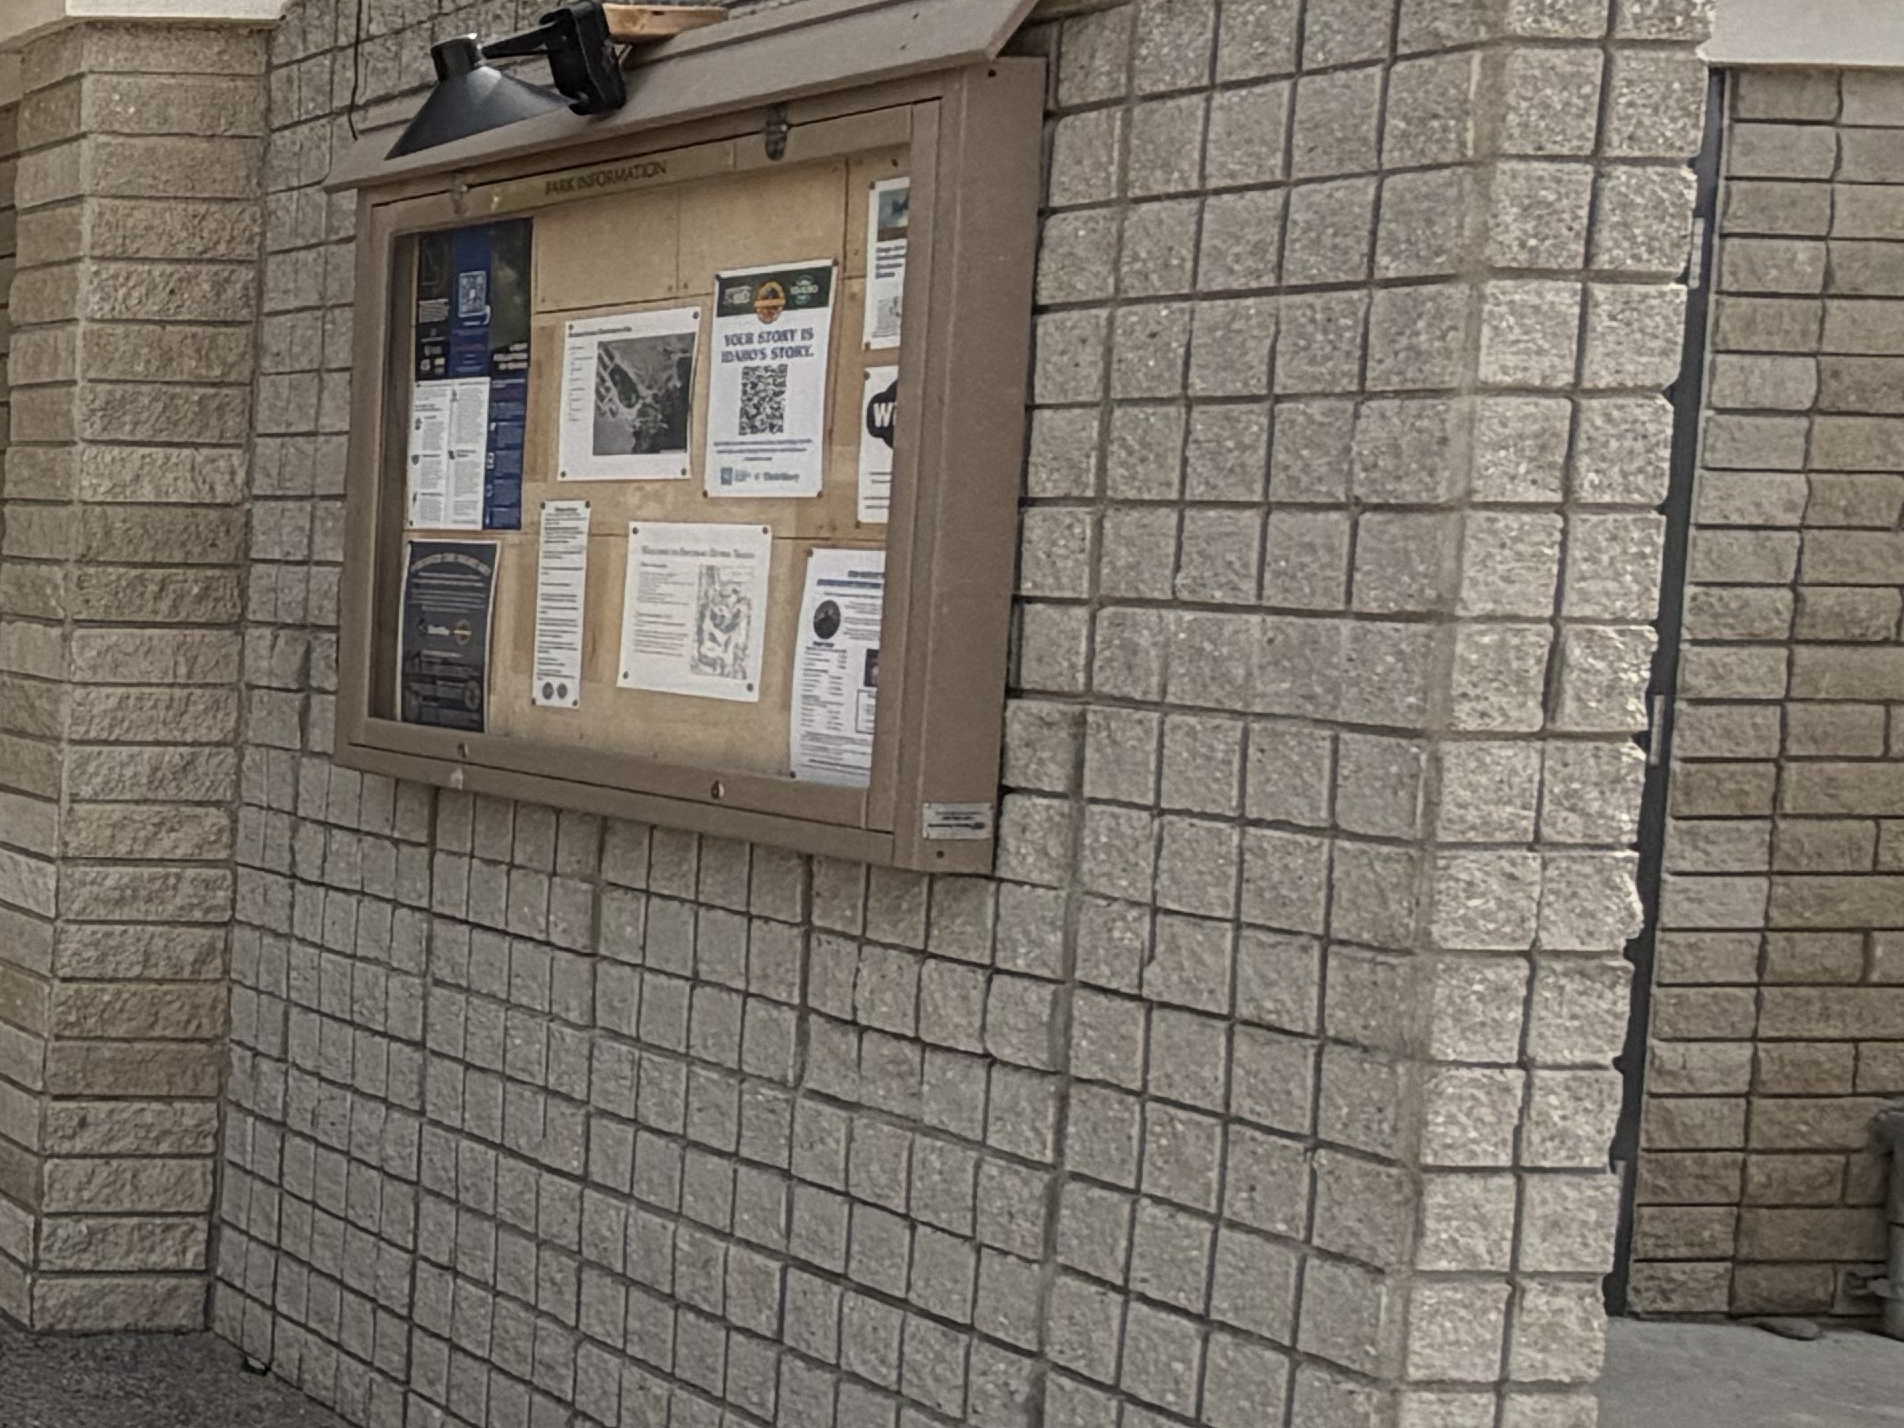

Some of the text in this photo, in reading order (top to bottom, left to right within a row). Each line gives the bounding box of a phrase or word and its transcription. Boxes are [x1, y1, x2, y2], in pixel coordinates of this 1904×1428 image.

[545, 159, 668, 195] PARK INFORMATION
[724, 327, 814, 347] YOUR STORY IS
[771, 345, 815, 360] STORY.
